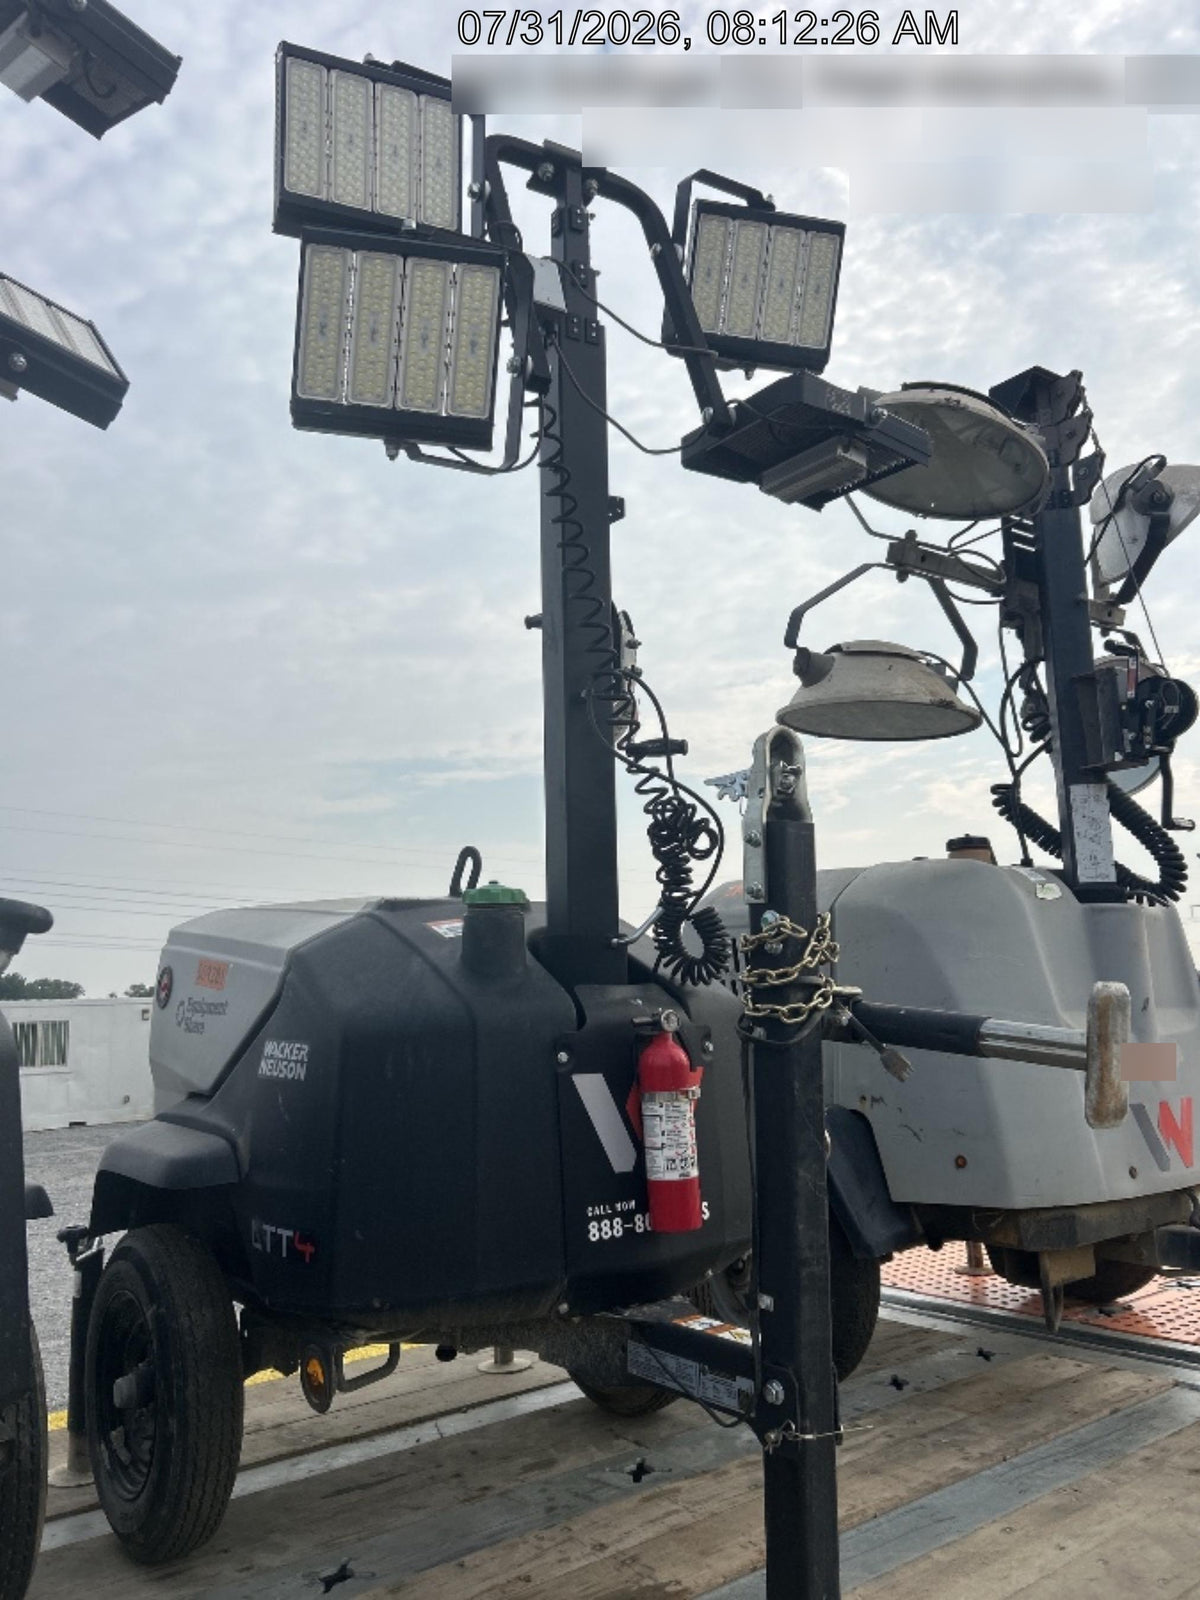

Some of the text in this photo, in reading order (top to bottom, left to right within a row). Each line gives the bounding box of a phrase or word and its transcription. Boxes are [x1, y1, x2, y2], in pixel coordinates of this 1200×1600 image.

[264, 1040, 308, 1062] WACKER
[258, 1058, 306, 1081] NEUSON
[587, 1199, 636, 1217] CALL NOW
[251, 1219, 315, 1263] LTT4
